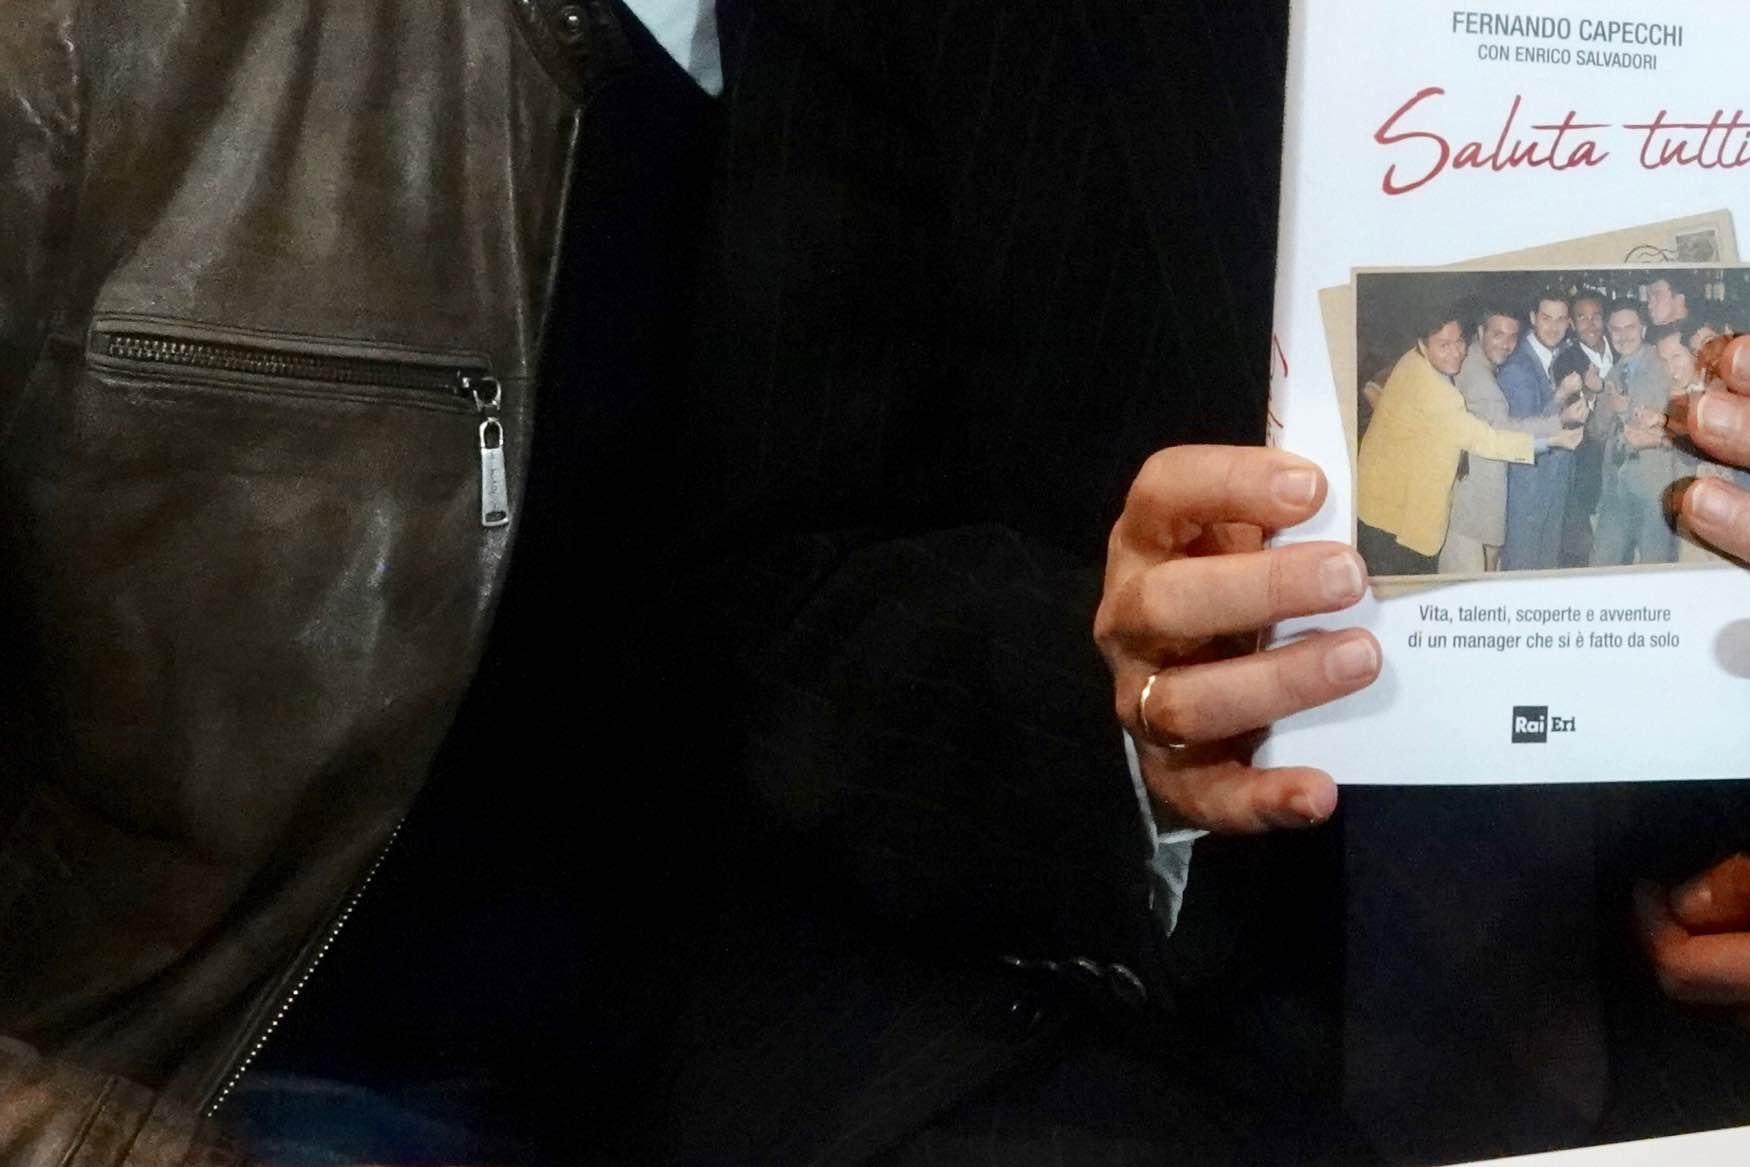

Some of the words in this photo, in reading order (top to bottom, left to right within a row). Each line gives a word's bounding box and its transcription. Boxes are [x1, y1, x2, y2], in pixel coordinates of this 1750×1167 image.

[1452, 11, 1571, 40] FERNANDO
[1579, 19, 1683, 47] CAPECCHI
[1478, 44, 1510, 61] CON
[1515, 47, 1571, 65] ENRICO
[1576, 50, 1657, 70] SALVADORI
[1373, 86, 1613, 196] Saluta
[1419, 605, 1453, 624] Vita,
[1458, 605, 1511, 624] talenti,
[1516, 606, 1581, 625] scoperte
[1586, 609, 1595, 622] e
[1599, 607, 1671, 622] avventure
[1408, 632, 1422, 649] di
[1428, 635, 1447, 648] un
[1453, 635, 1520, 651] manager
[1526, 632, 1552, 648] che
[1558, 632, 1571, 648] si
[1576, 631, 1585, 648] è
[1589, 632, 1622, 648] fatto
[1627, 632, 1645, 648] da
[1650, 631, 1679, 648] solo
[1515, 716, 1545, 734] Rai
[1551, 717, 1576, 732] Eri
